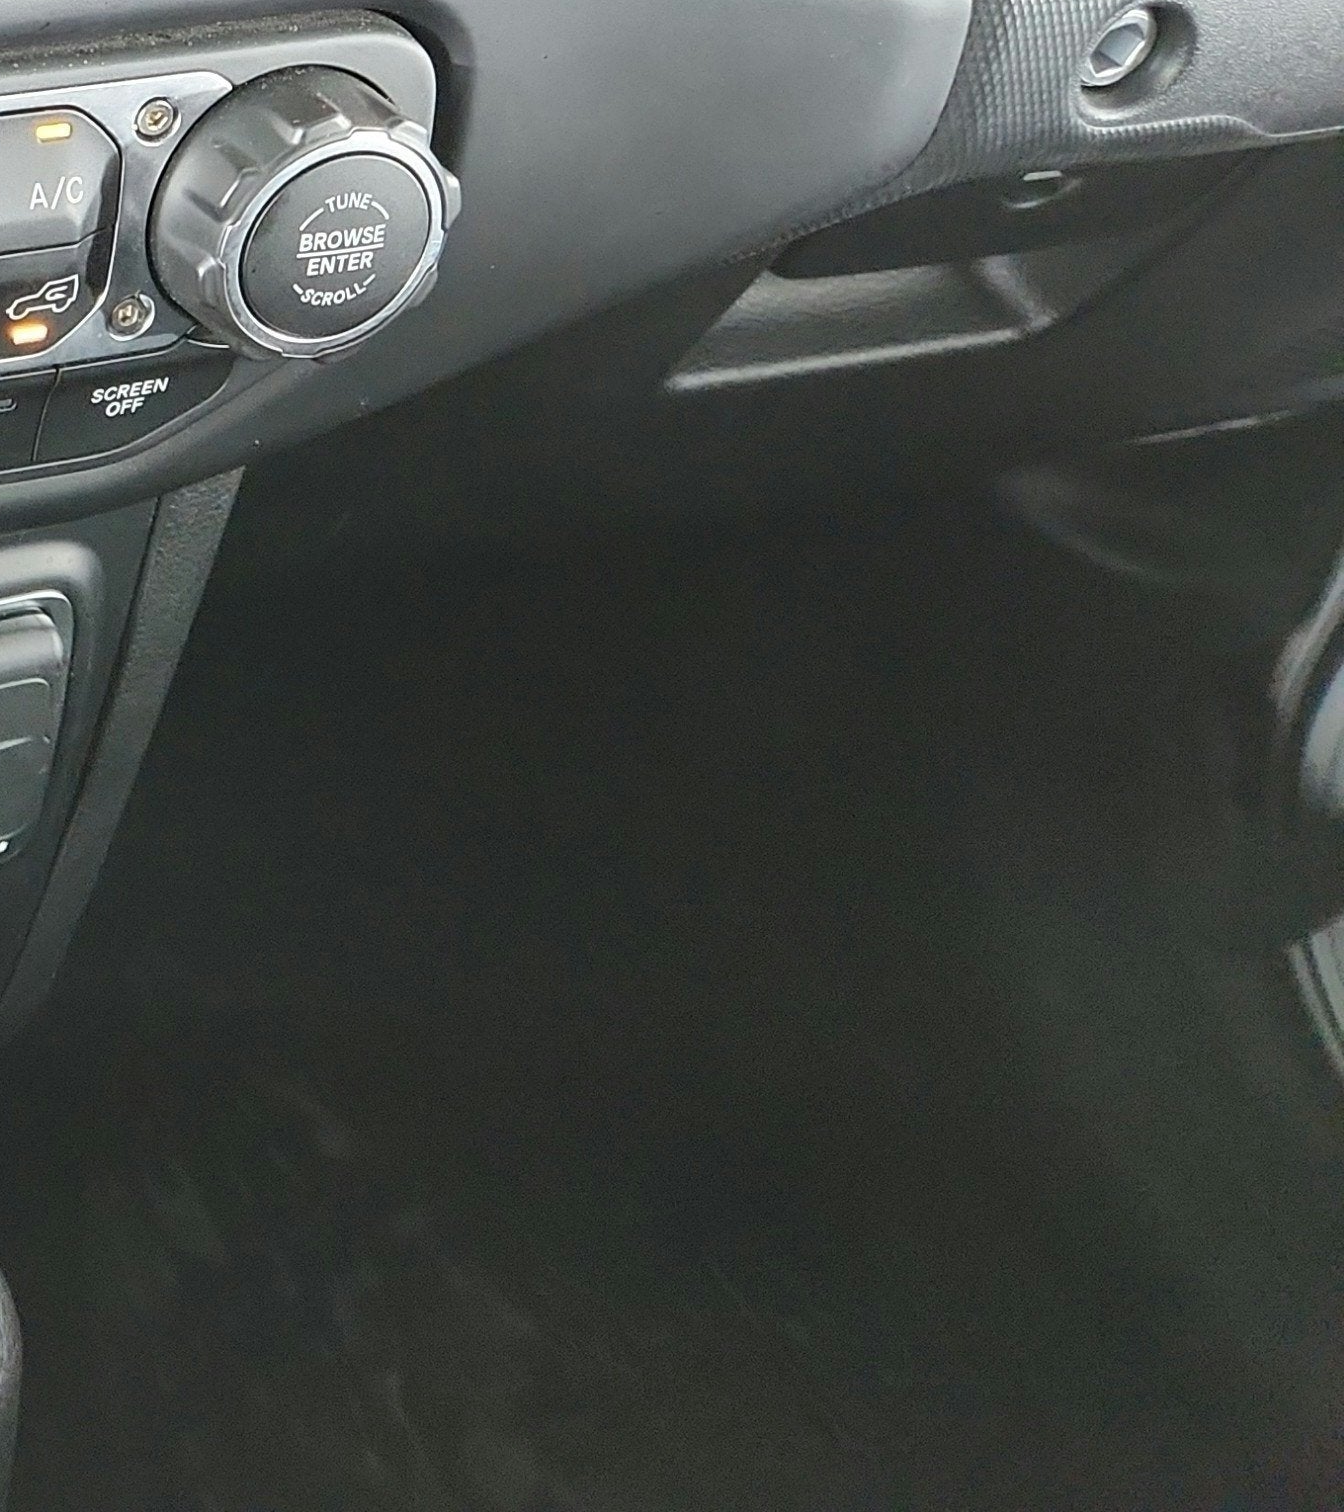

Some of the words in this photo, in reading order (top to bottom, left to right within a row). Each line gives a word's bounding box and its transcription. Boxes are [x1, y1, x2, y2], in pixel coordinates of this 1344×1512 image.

[29, 175, 85, 212] A/C
[324, 191, 373, 213] TUNE
[296, 223, 387, 254] BROWSE
[305, 251, 375, 277] ENTER
[298, 282, 367, 306] SCROLL
[90, 376, 170, 406] SCREEN
[103, 395, 145, 417] OFF
